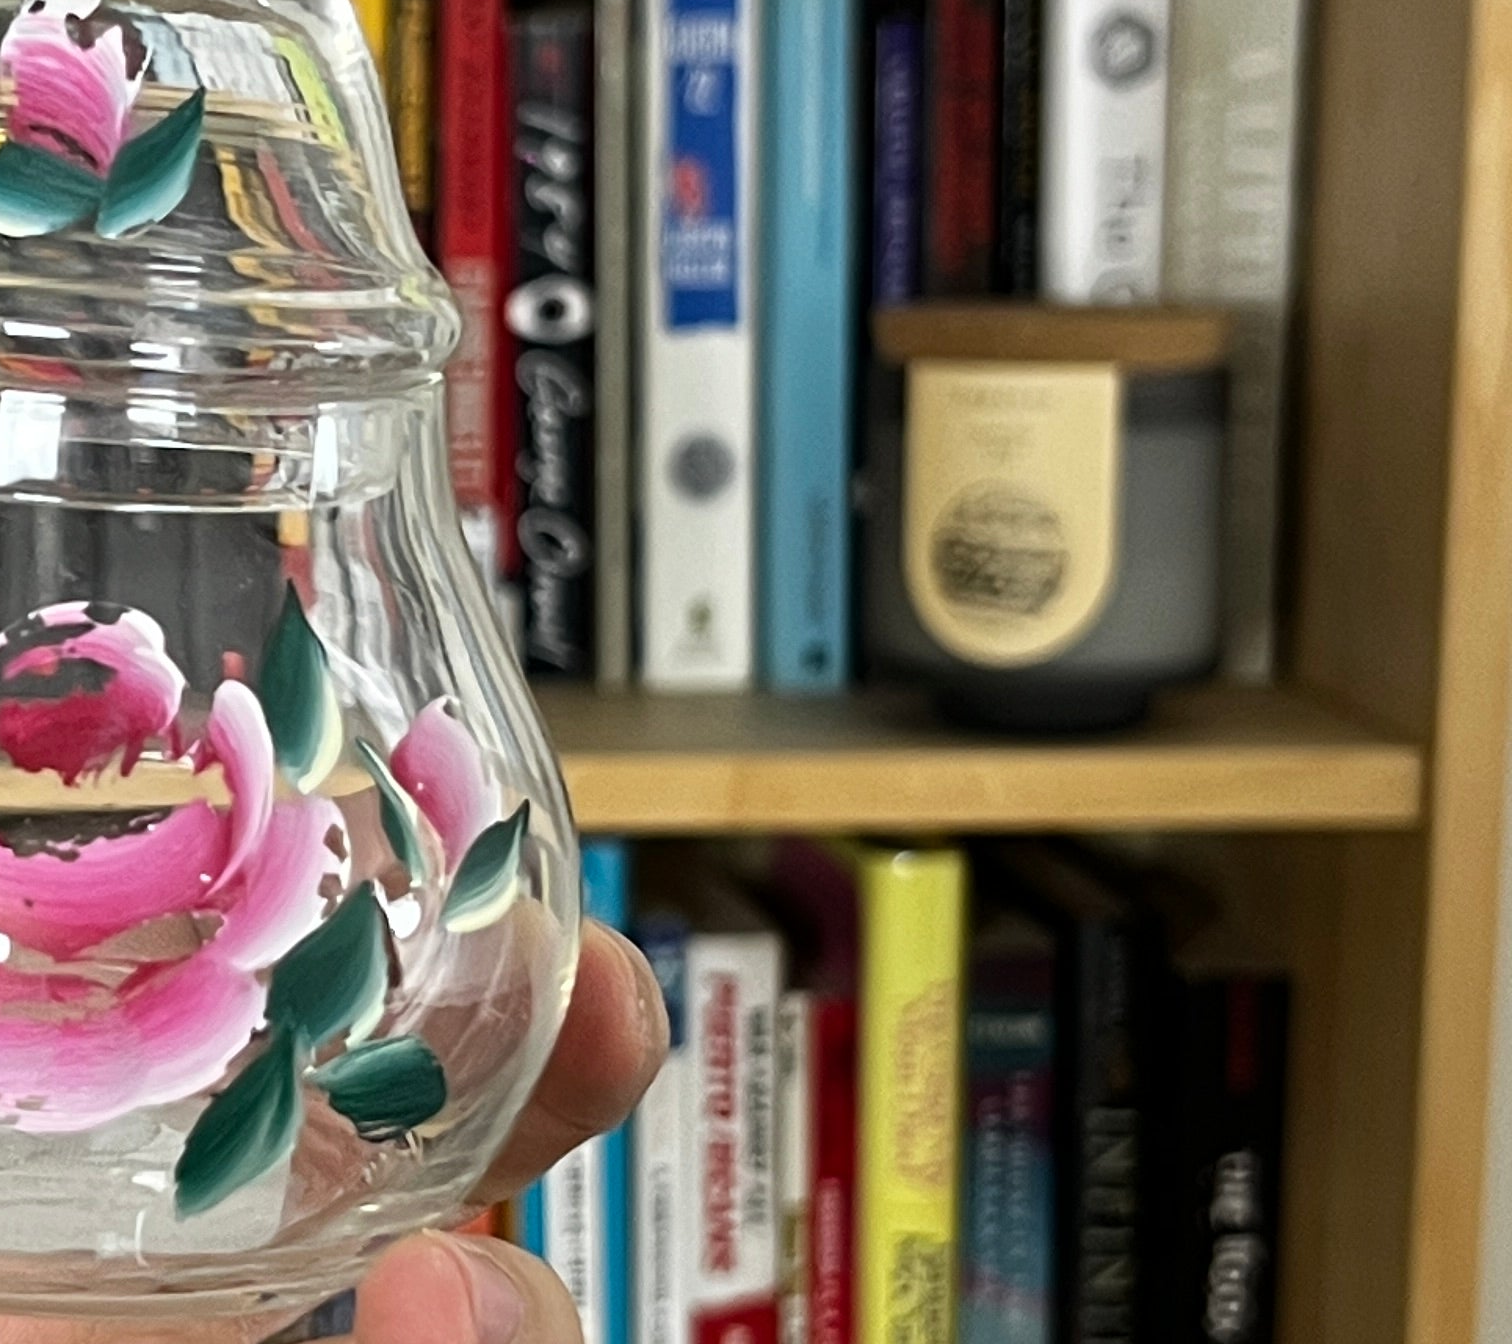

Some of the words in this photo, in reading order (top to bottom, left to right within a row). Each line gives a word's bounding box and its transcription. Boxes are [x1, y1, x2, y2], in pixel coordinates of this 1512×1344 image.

[515, 98, 589, 268] 1984
[515, 348, 587, 502] George
[517, 506, 591, 670] Orwell
